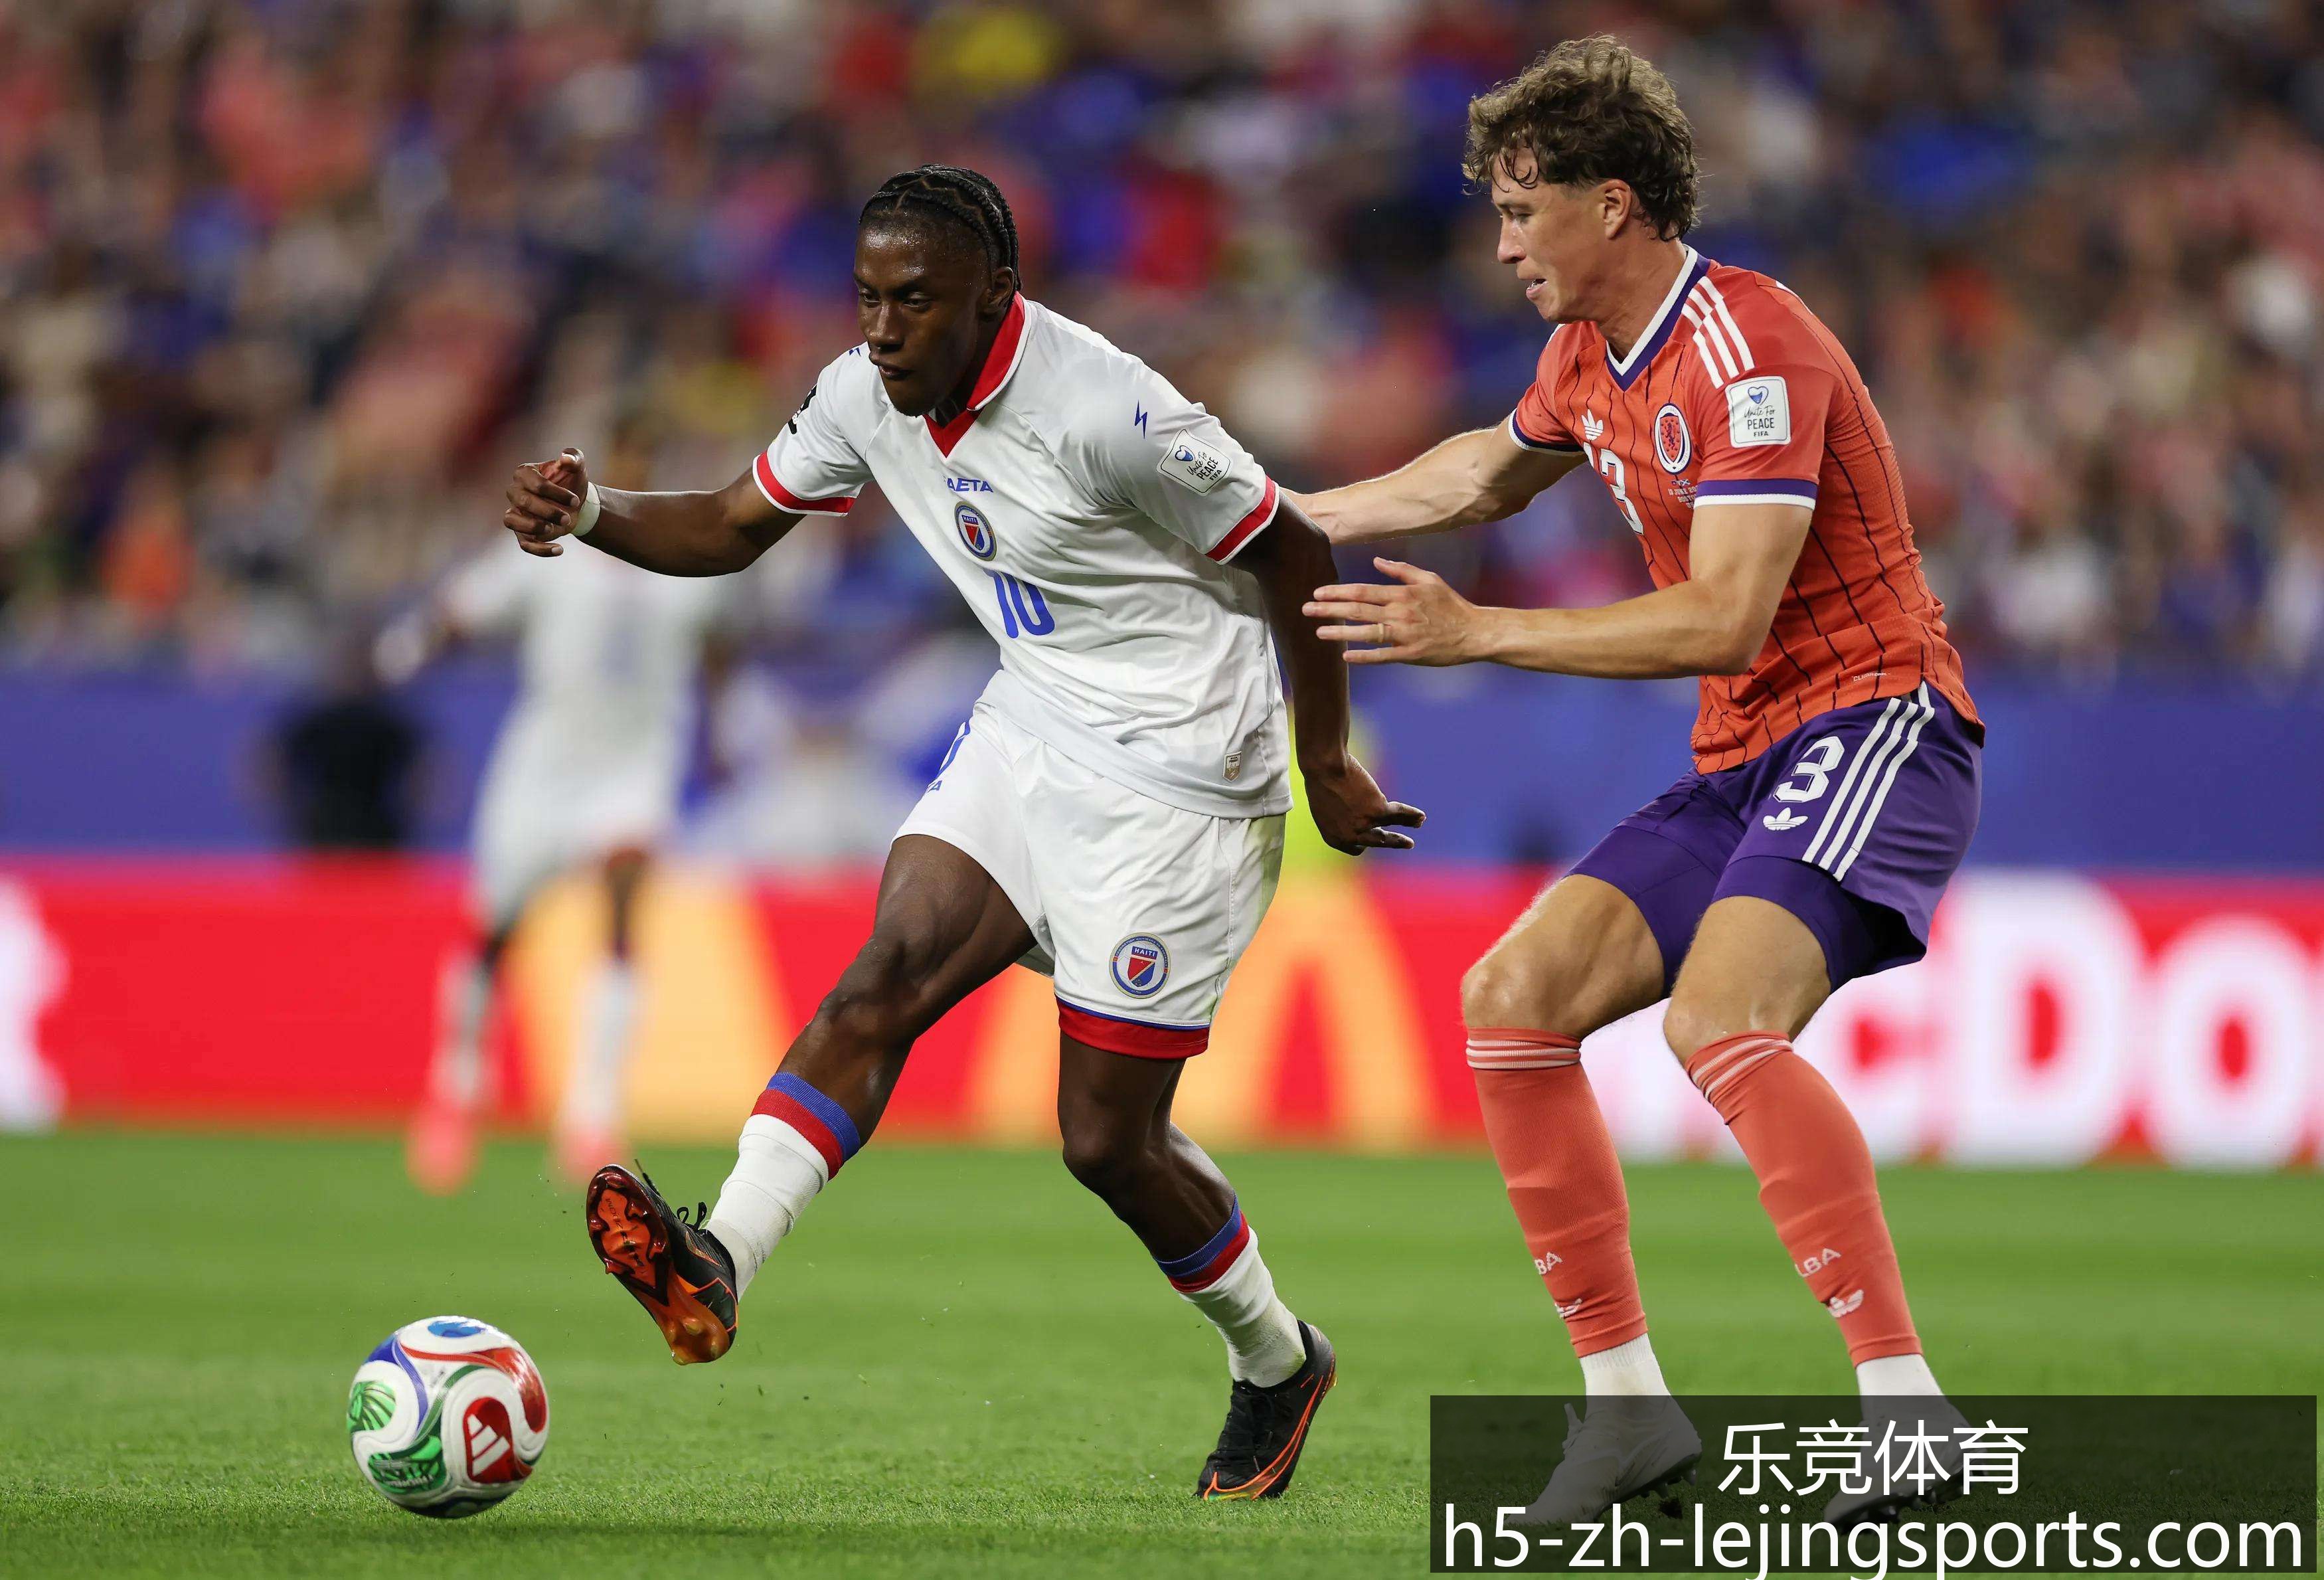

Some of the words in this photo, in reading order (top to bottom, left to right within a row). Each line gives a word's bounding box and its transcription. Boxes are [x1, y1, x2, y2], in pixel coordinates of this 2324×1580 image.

[1744, 406, 1764, 418] Unite
[1765, 405, 1776, 416] For
[1748, 418, 1774, 430] PEACE
[1197, 458, 1218, 480] PEACE
[1210, 470, 1222, 481] FIFA
[943, 476, 994, 493] AETA
[983, 569, 1055, 639] 10
[1134, 948, 1155, 957] HAITI
[1582, 867, 2324, 1166] cDo
[1535, 1252, 1562, 1275] BA
[1795, 1248, 1841, 1277] LBA
